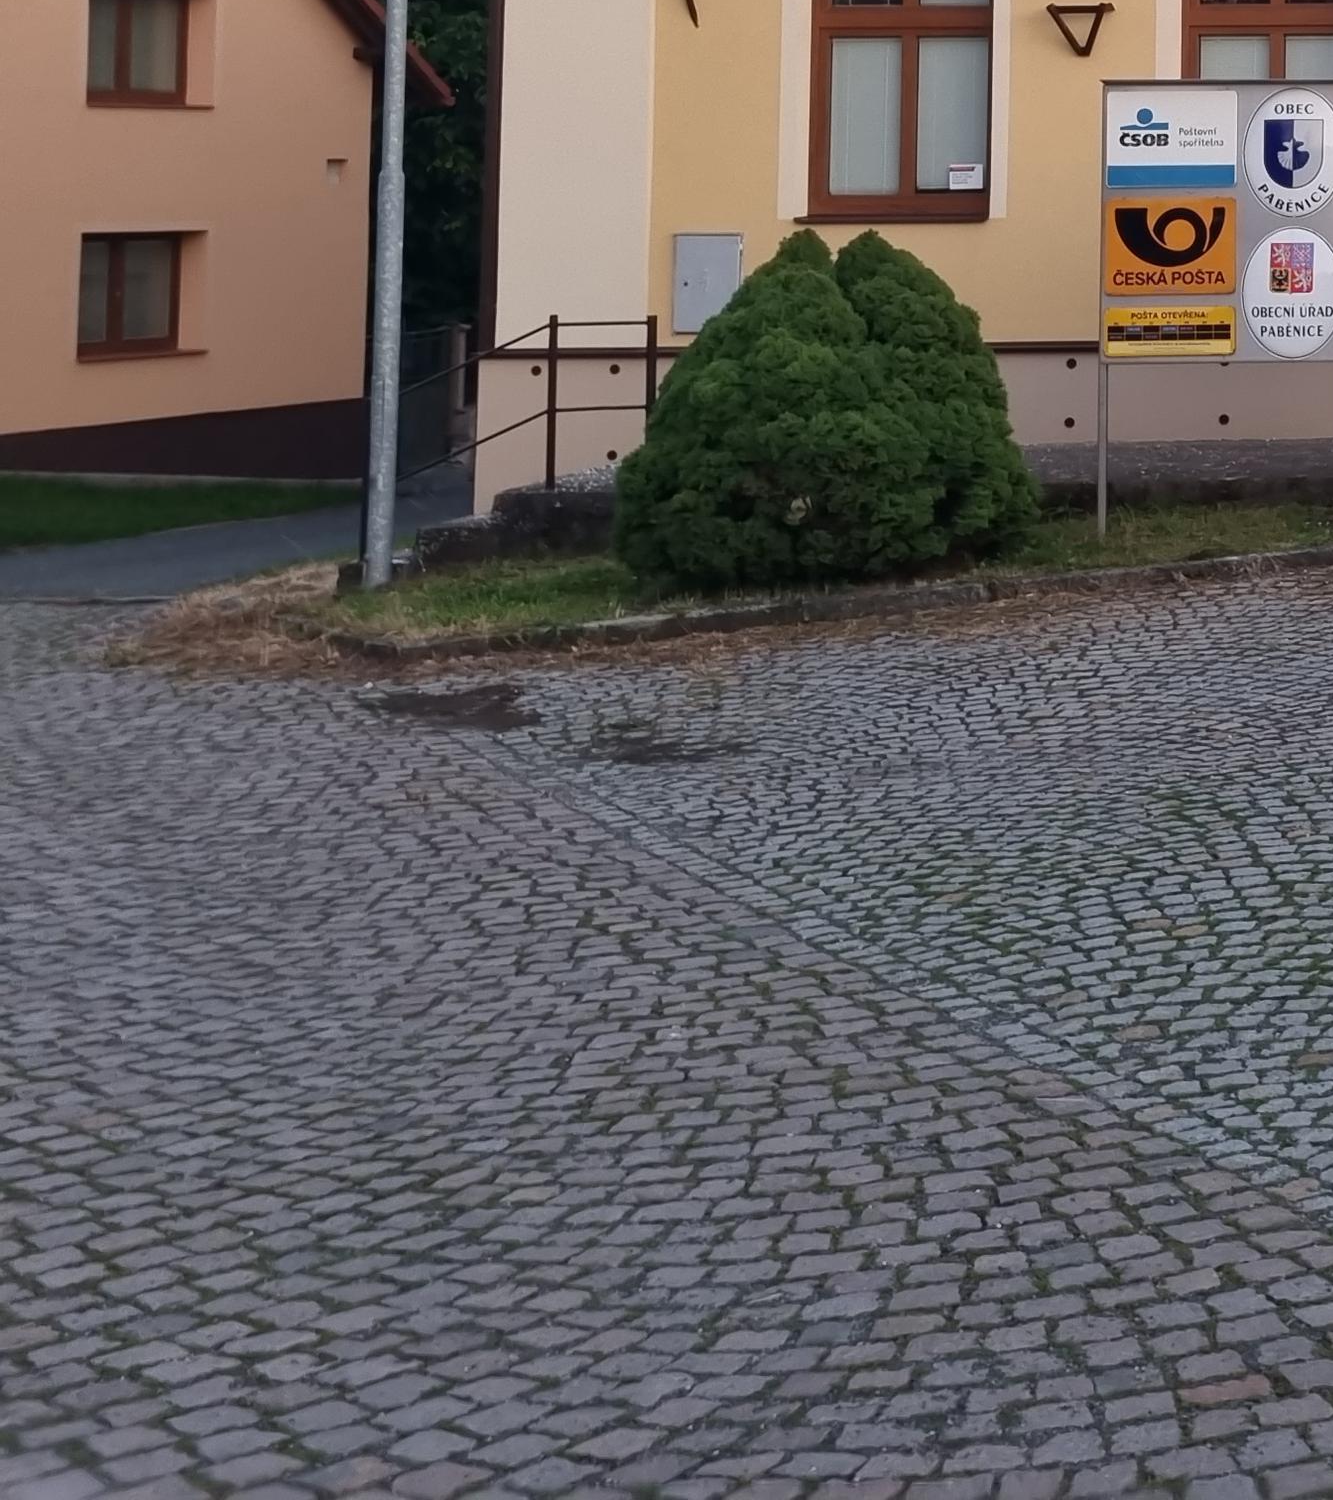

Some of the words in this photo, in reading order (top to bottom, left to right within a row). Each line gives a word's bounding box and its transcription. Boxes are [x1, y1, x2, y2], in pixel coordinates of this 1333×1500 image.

[1274, 104, 1314, 115] OBEC
[1178, 127, 1217, 136] Poštovní
[1119, 132, 1169, 147] ČSOB
[1178, 138, 1224, 148] spořitelna
[1258, 183, 1329, 212] PABĚNICE
[1113, 269, 1168, 286] ČESKÁ
[1171, 269, 1225, 285] POŠTA
[1131, 309, 1158, 319] POŠTA
[1251, 303, 1295, 318] OBECNÍ
[1299, 303, 1333, 317] ÚŘAD
[1260, 323, 1324, 337] PABĚNICE
